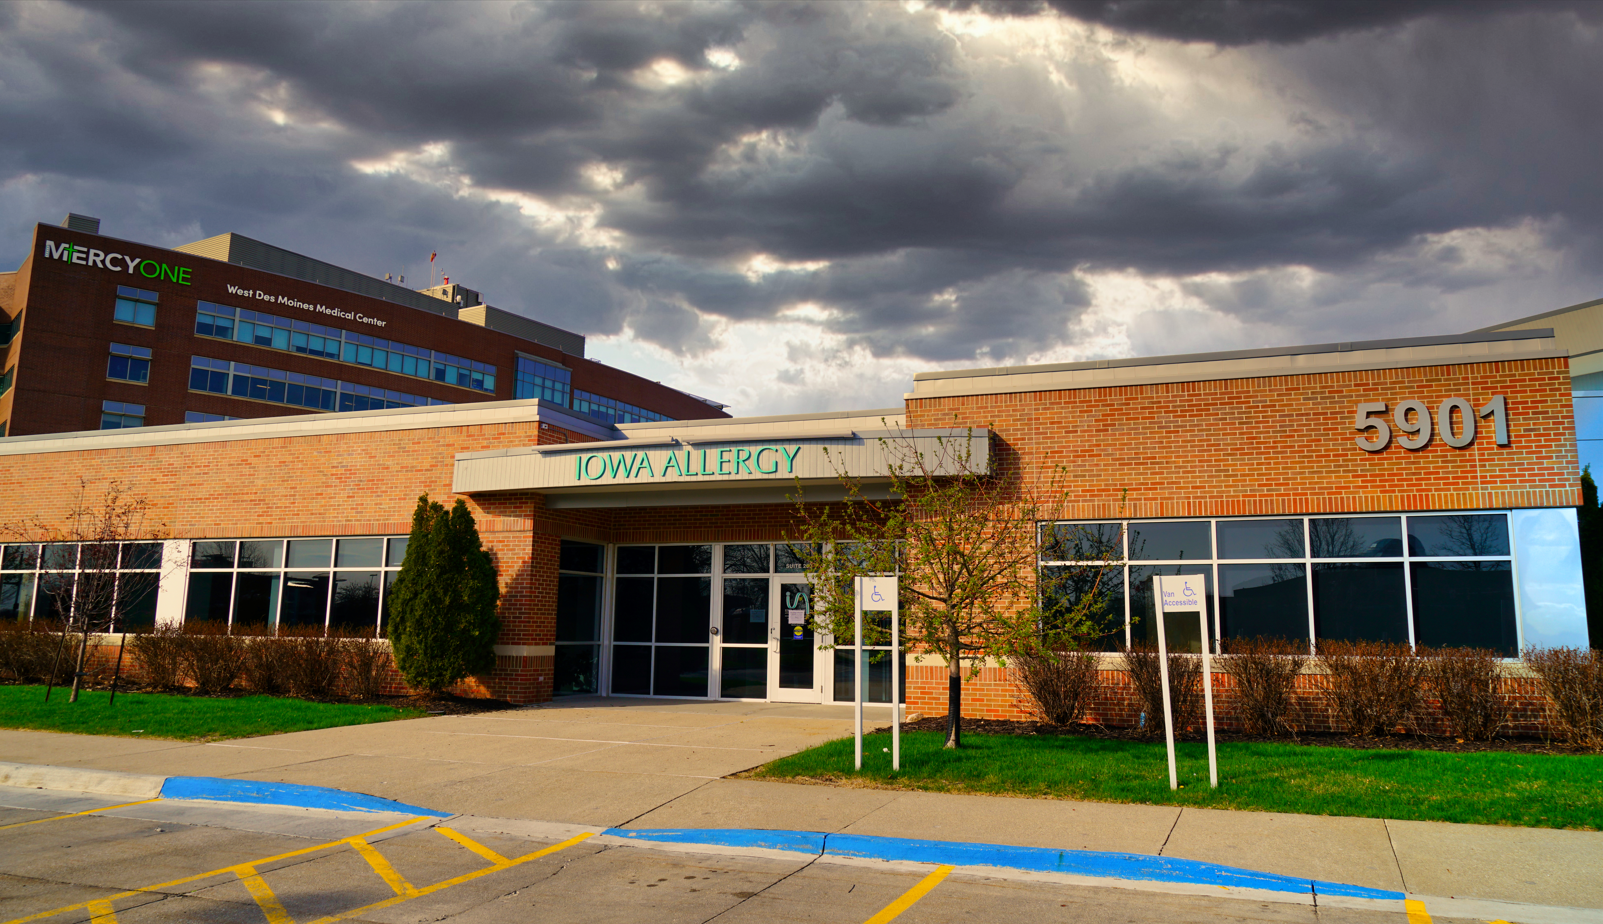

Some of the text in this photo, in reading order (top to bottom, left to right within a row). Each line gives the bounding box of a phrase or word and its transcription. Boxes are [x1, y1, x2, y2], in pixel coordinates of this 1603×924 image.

[227, 284, 387, 328] West Des Moines Medical Center
[1355, 395, 1508, 451] 5901
[575, 446, 801, 480] IOWA ALLERGY
[1163, 590, 1175, 598] Van
[1163, 599, 1198, 607] Accessible
